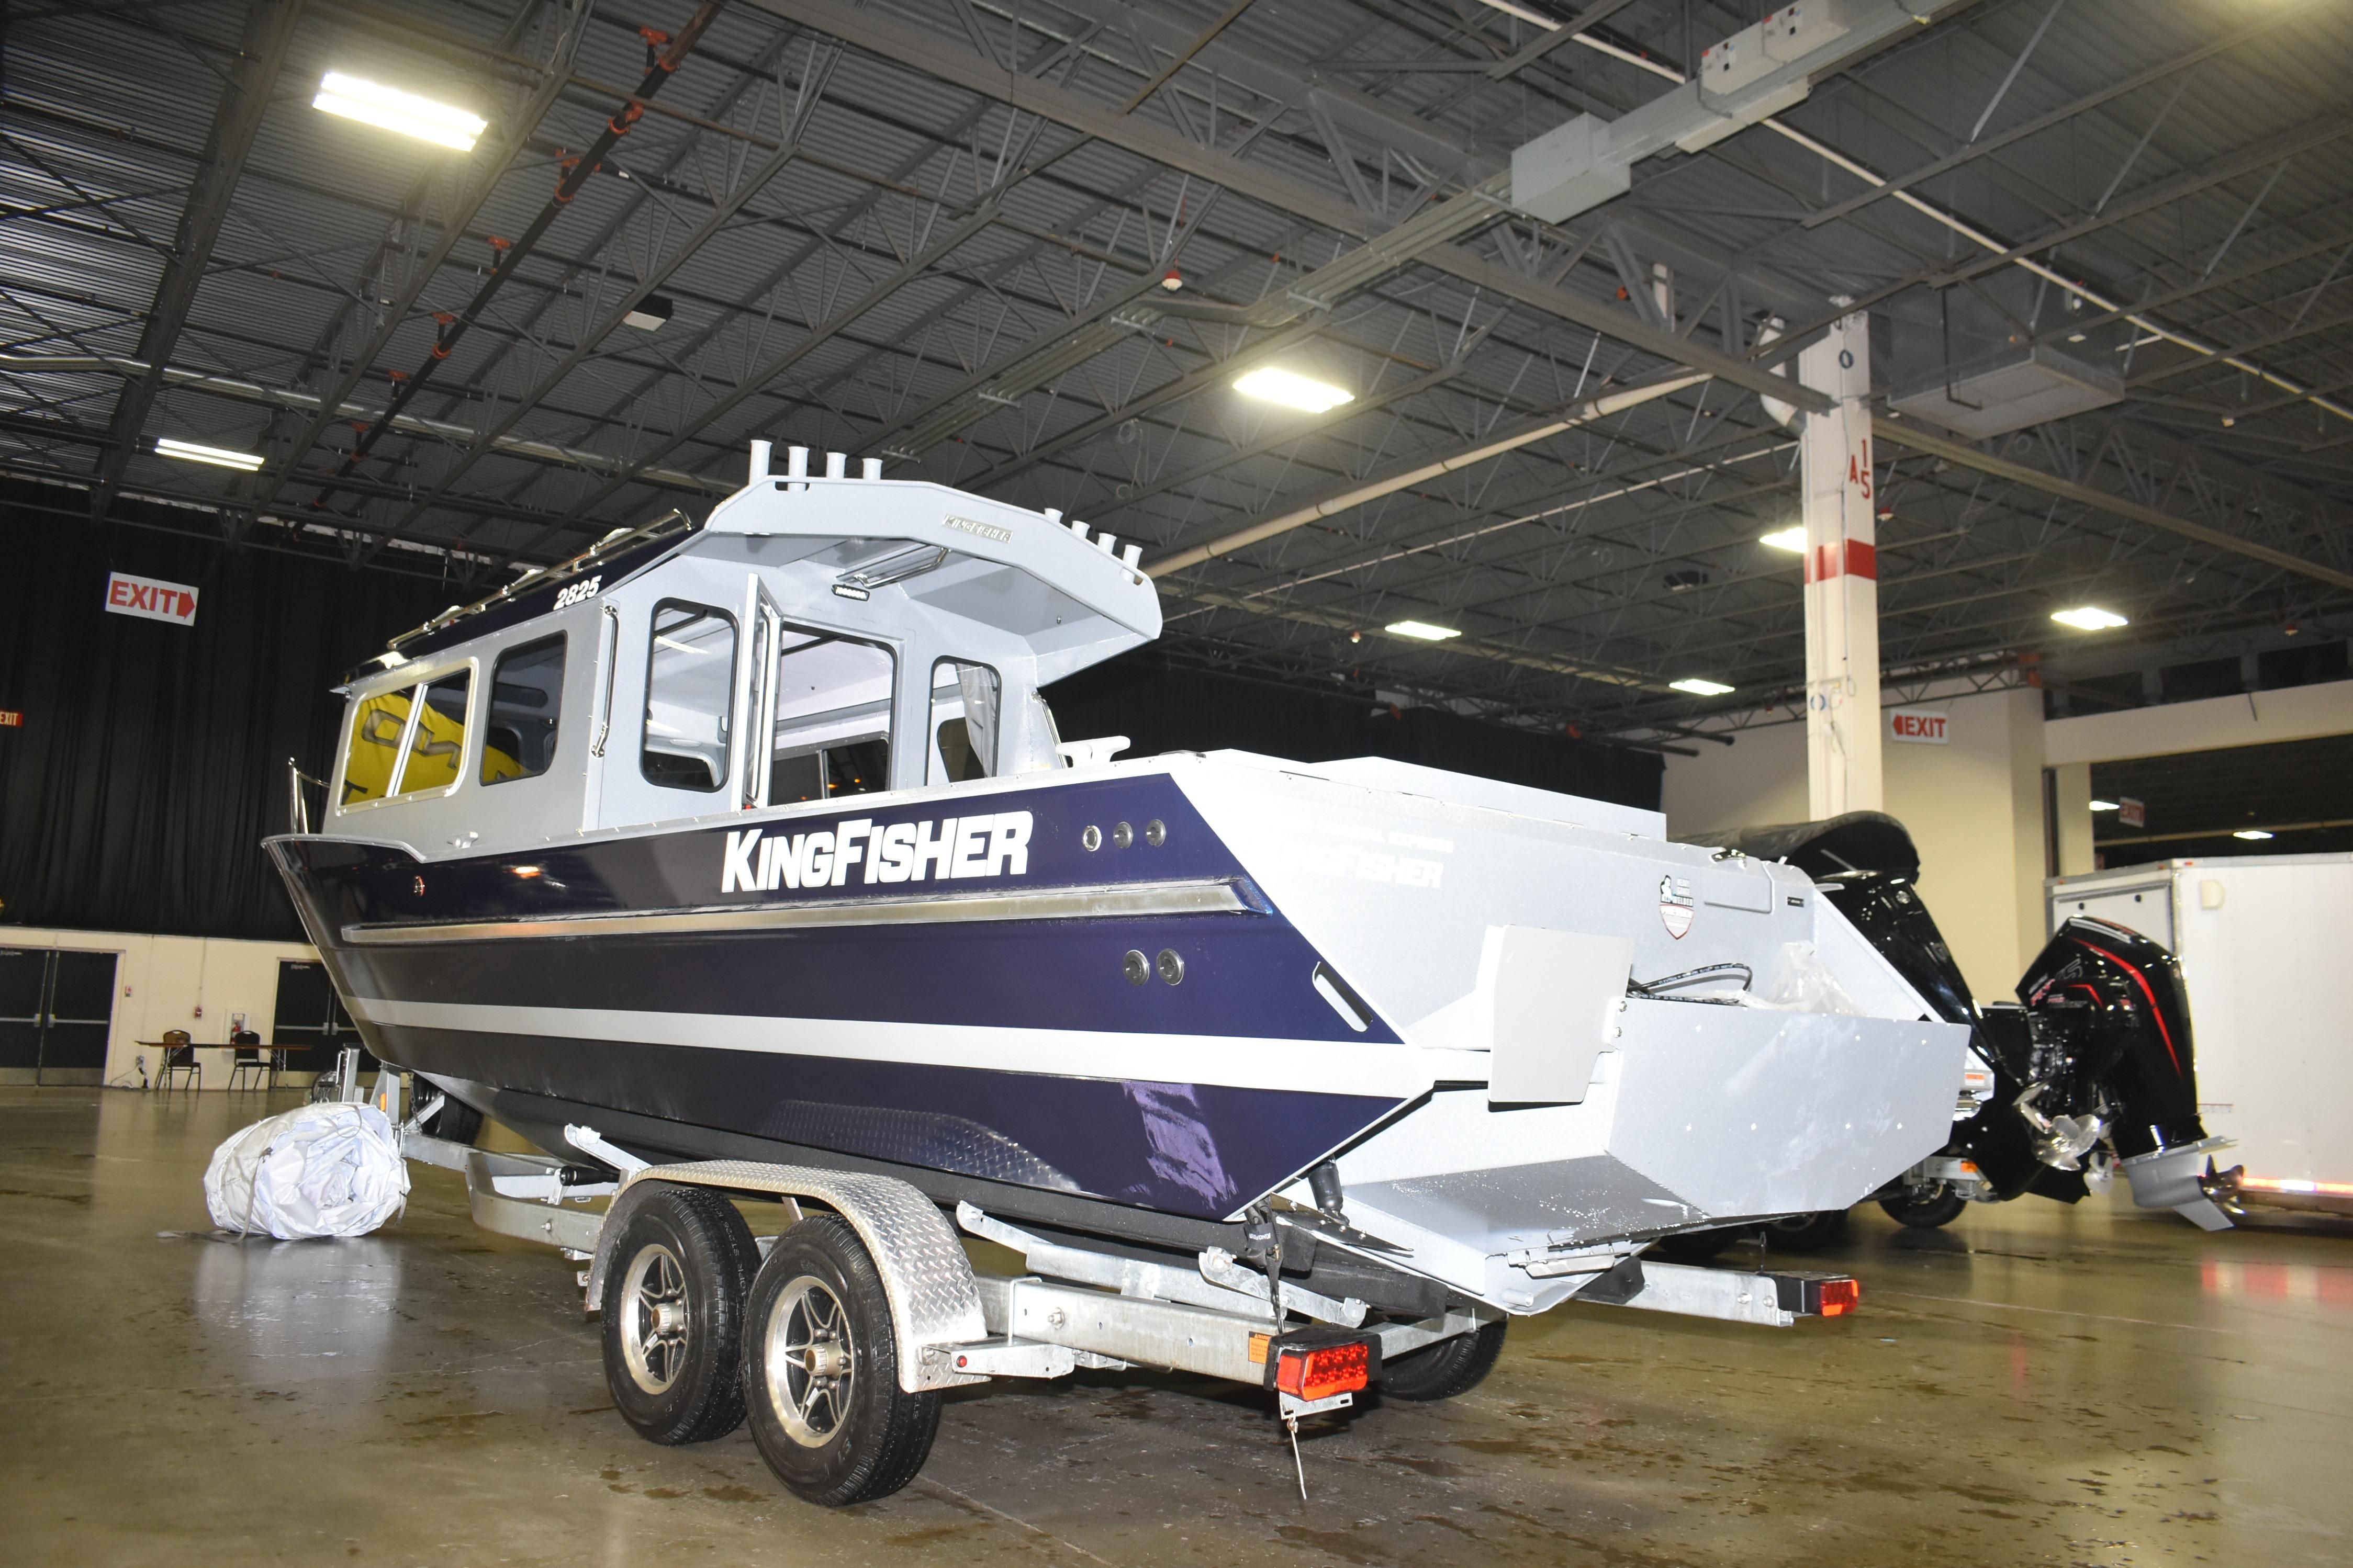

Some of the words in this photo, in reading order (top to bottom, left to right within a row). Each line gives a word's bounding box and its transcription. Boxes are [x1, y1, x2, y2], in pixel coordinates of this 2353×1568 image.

[109, 579, 178, 614] EXIT
[553, 575, 602, 611] 2825
[0, 711, 18, 726] EXIT
[1905, 715, 1947, 738] EXIT
[721, 810, 1034, 893] KINGFISHER
